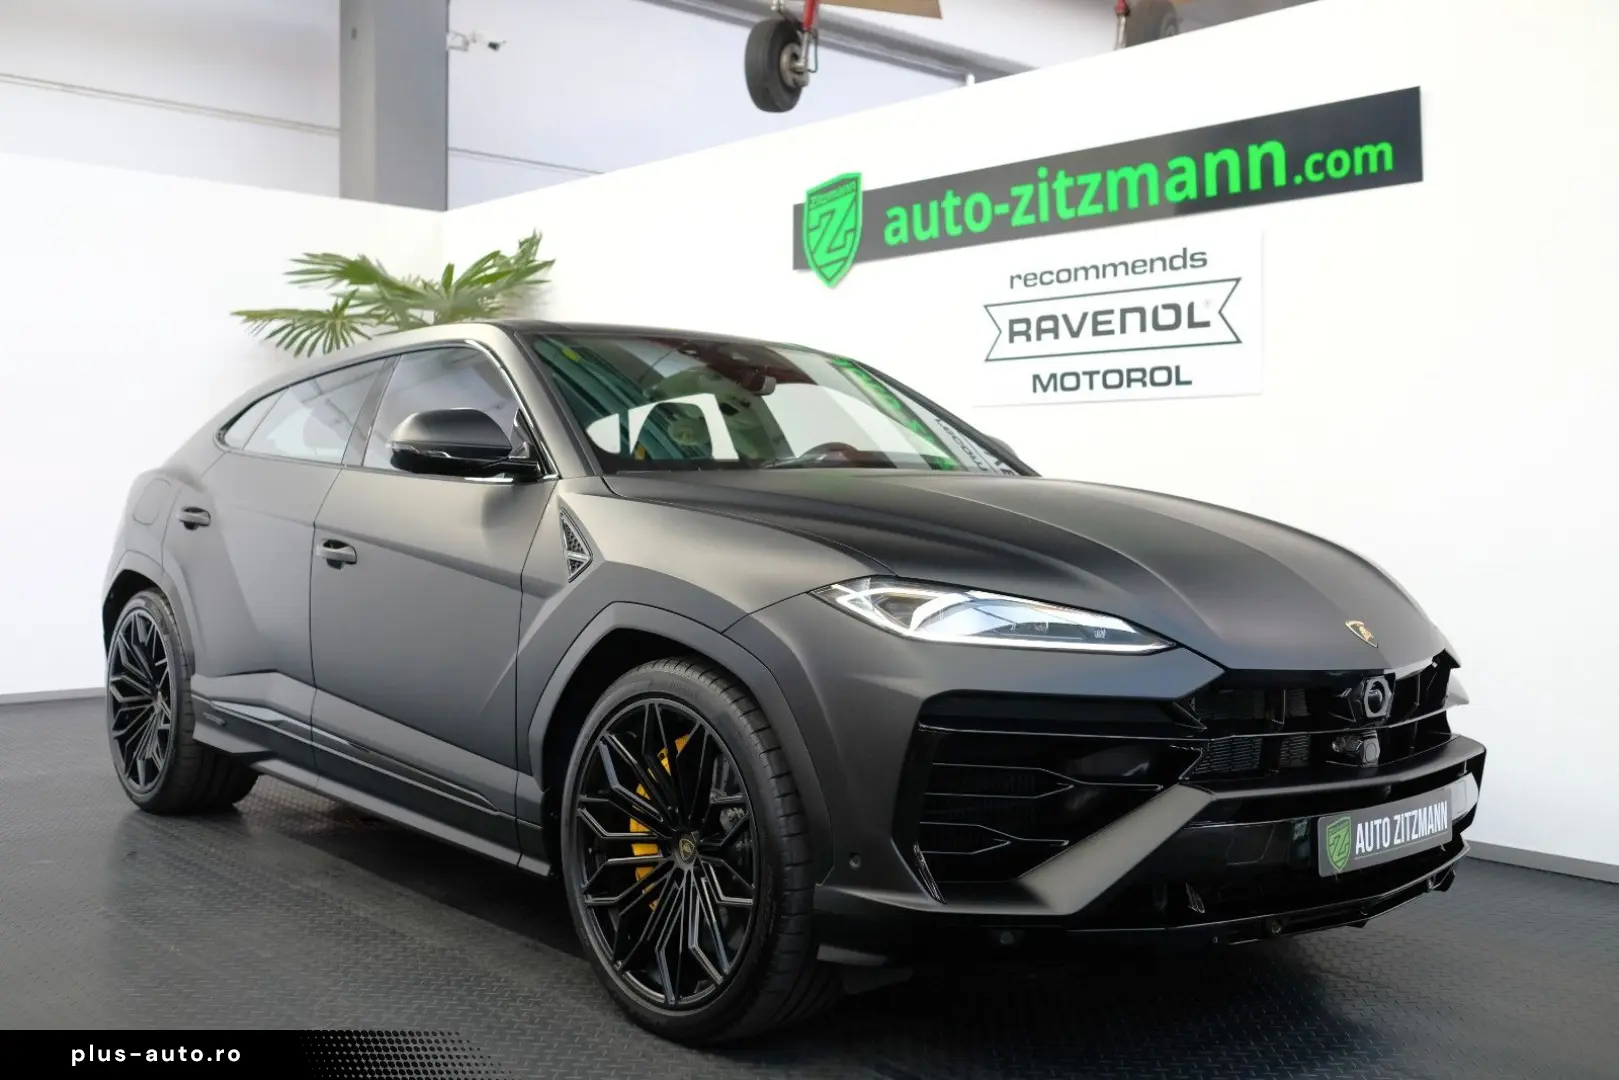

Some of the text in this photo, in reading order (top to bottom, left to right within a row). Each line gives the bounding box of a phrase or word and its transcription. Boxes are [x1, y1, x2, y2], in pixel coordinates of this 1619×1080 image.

[883, 138, 1395, 247] auto-zitzmann.com
[1009, 247, 1208, 290] recommends
[1008, 301, 1211, 344] RAVENOL
[1032, 365, 1193, 394] MOTOROL
[1355, 800, 1448, 855] AUTO ZITZMANN
